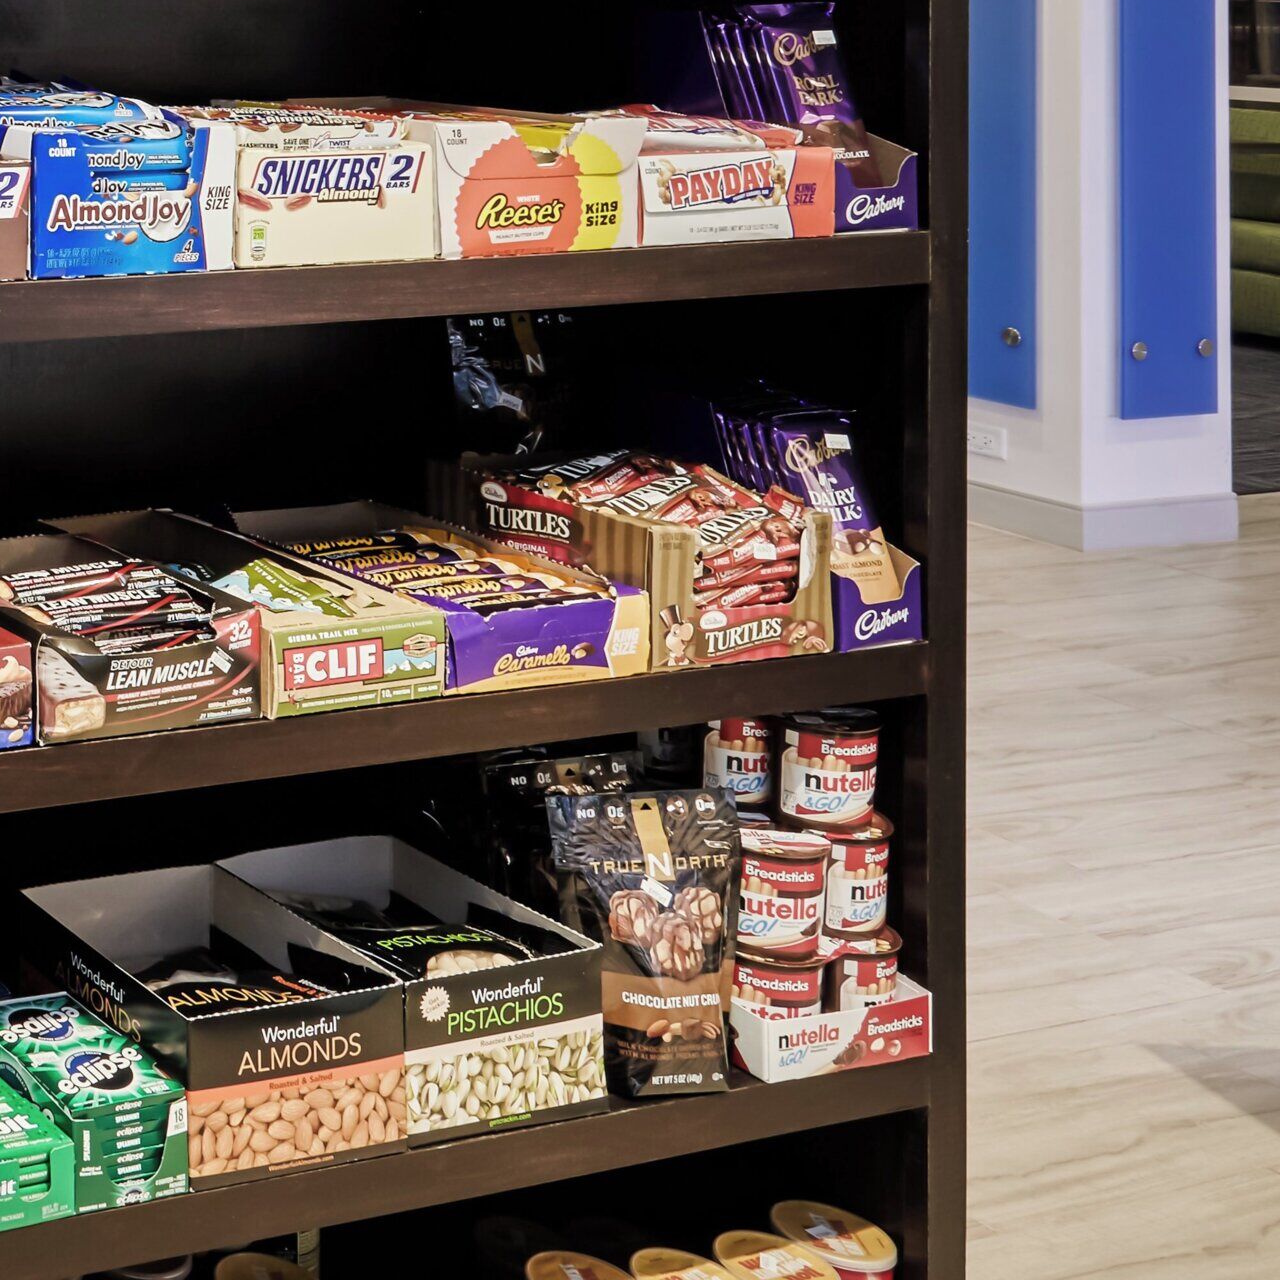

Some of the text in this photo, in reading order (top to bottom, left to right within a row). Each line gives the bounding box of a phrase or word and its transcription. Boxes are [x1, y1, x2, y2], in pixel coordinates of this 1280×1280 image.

[49, 146, 76, 158] COUNT
[258, 157, 380, 196] SNICKERS
[672, 157, 775, 208] PAYDAY
[205, 196, 229, 210] SIZE
[206, 185, 231, 200] KING
[47, 195, 146, 231] Almond
[145, 195, 191, 232] Joy
[476, 192, 565, 228] Reese's
[845, 193, 904, 224] Cadbury
[174, 251, 199, 263] PIECES
[809, 491, 857, 507] DAIRY
[486, 504, 571, 538] TURTLES
[704, 618, 783, 655] TURTLES
[854, 607, 910, 640] Cadbury
[107, 658, 215, 691] LEAN MUSCLE
[293, 653, 305, 685] BAR
[305, 644, 376, 682] CLIF
[493, 645, 571, 676] Caramello
[589, 858, 641, 875] TRUE
[745, 868, 815, 884] Breadsticks
[472, 978, 542, 1005] Wonderful
[738, 969, 809, 992] Breadsticks
[447, 993, 564, 1036] PISTACHIOS
[622, 991, 700, 1009] CHOCOLATE NUT
[262, 1017, 338, 1044] Wonderful
[779, 1024, 840, 1050] nutella
[238, 1032, 362, 1076] ALMONDS
[58, 1046, 143, 1095] eclipse
[173, 1108, 184, 1123] 18
